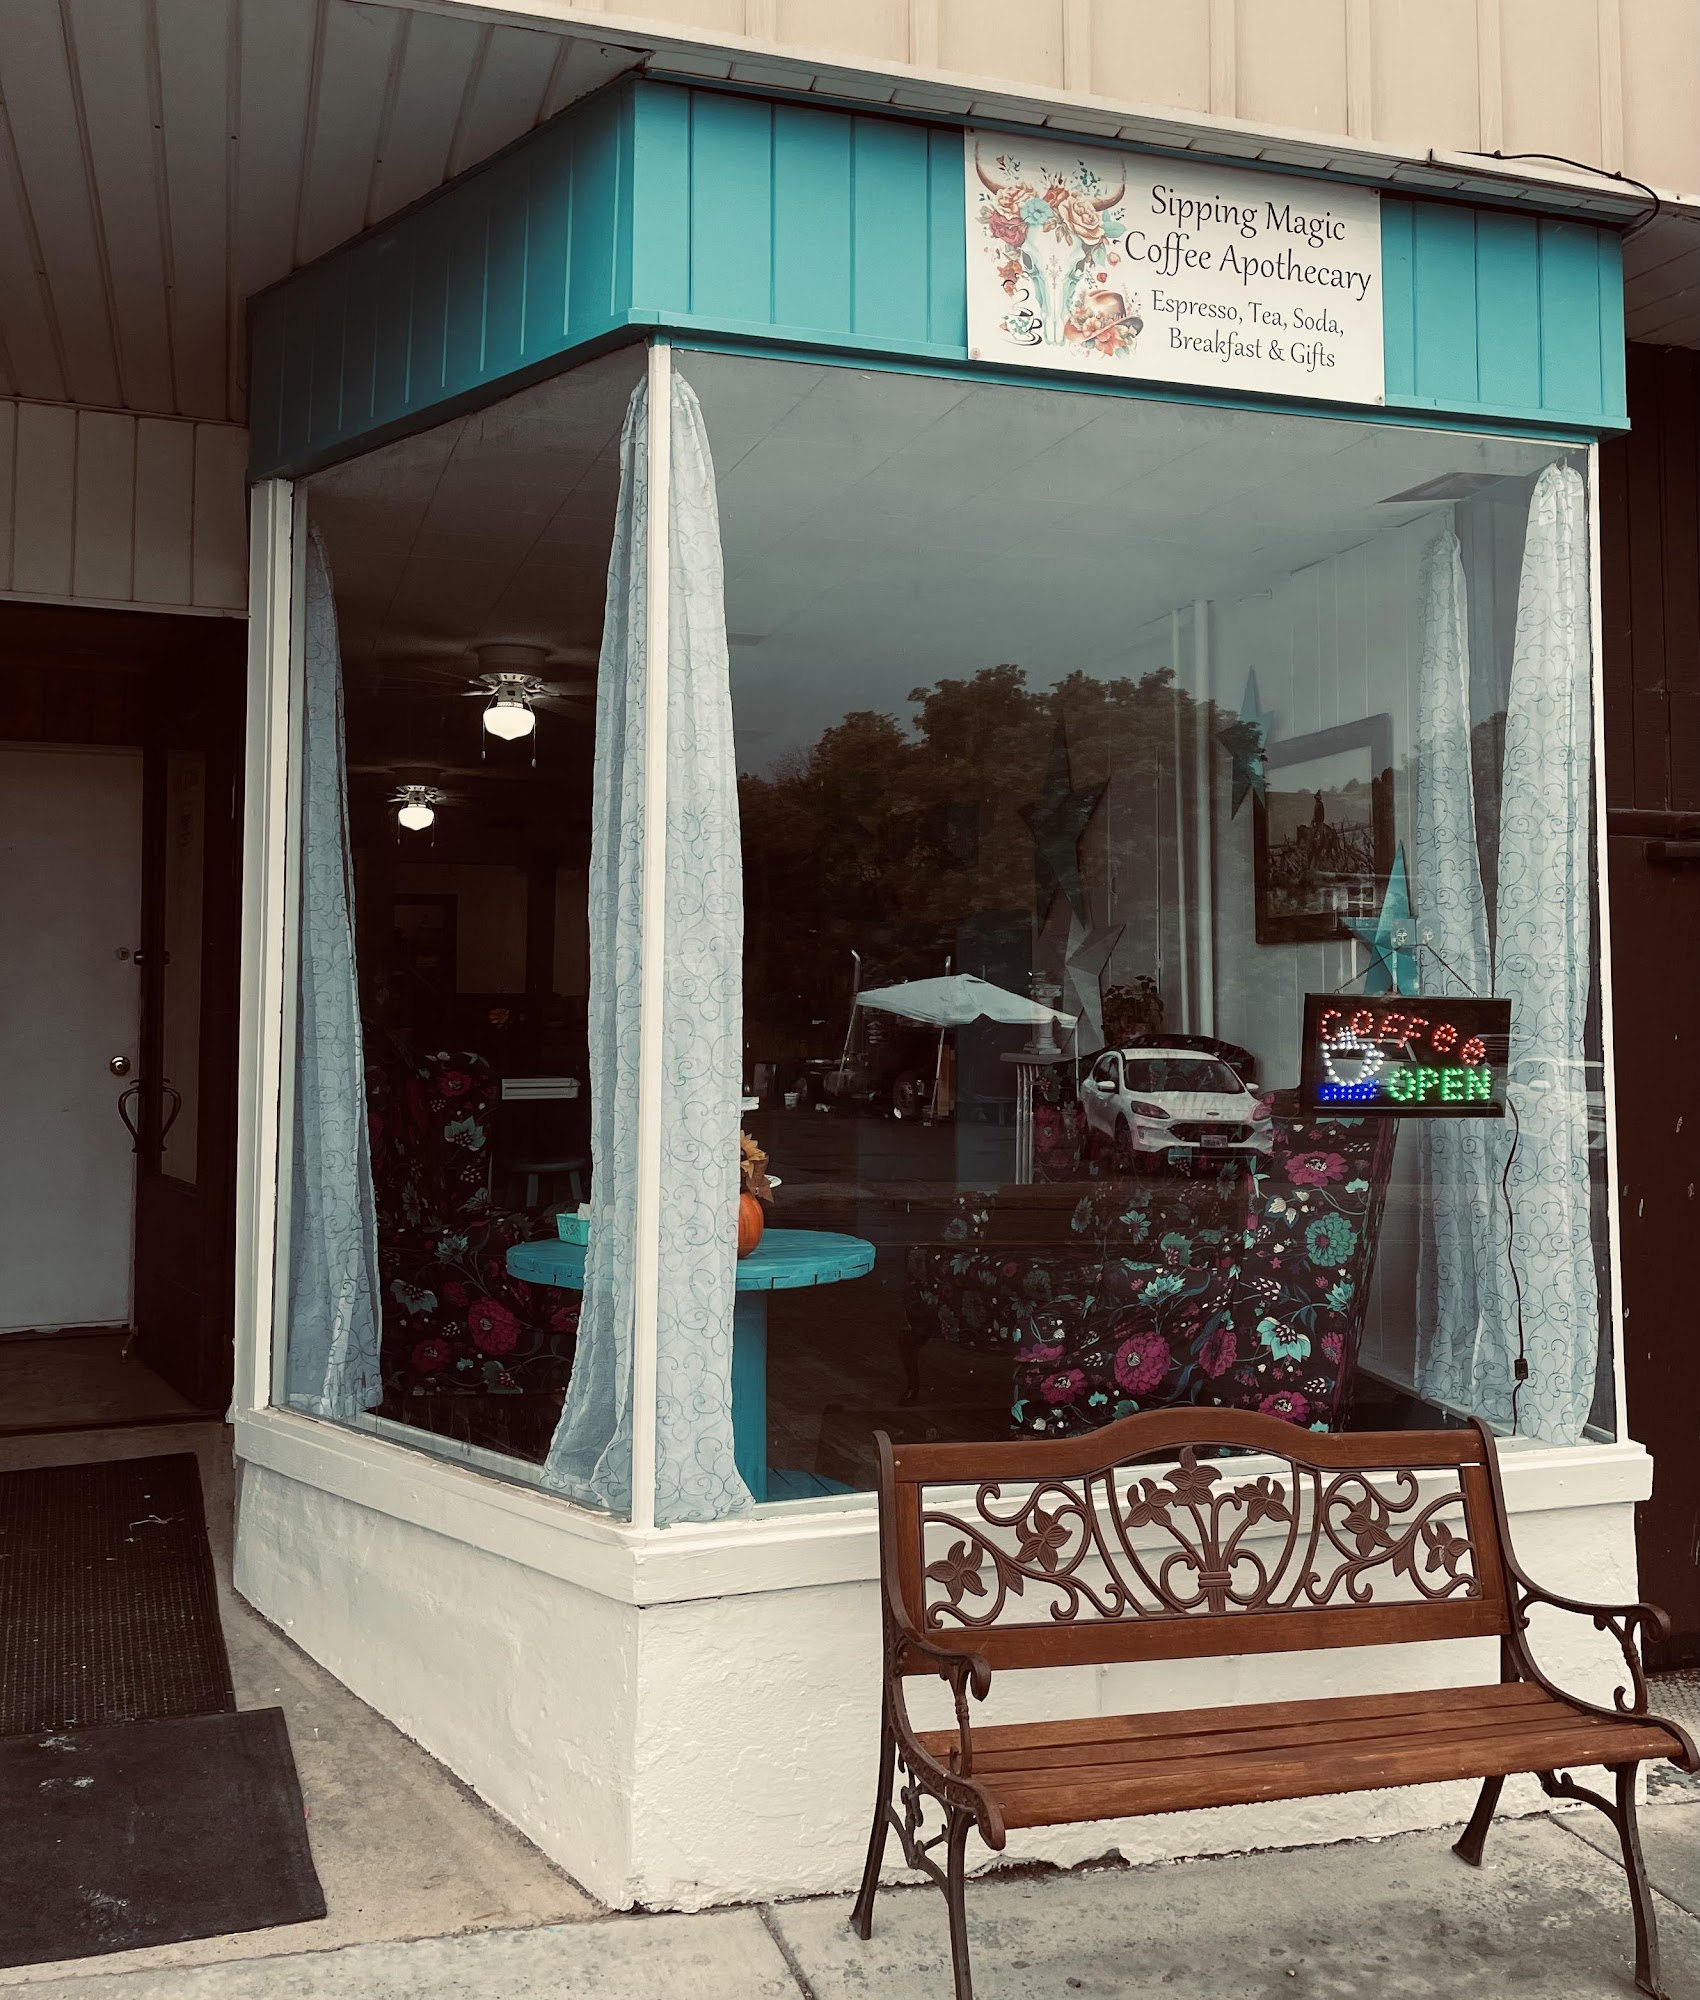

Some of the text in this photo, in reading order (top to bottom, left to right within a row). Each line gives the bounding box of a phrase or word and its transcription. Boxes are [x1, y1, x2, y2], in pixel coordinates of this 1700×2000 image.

[1151, 184, 1345, 249] Sipping Magic
[1125, 231, 1372, 302] Coffee Apothecary
[1151, 289, 1345, 338] Espresso, Tea, Soda,
[1169, 327, 1336, 373] Breakfast & Gifts
[1387, 1066, 1492, 1102] OPEN
